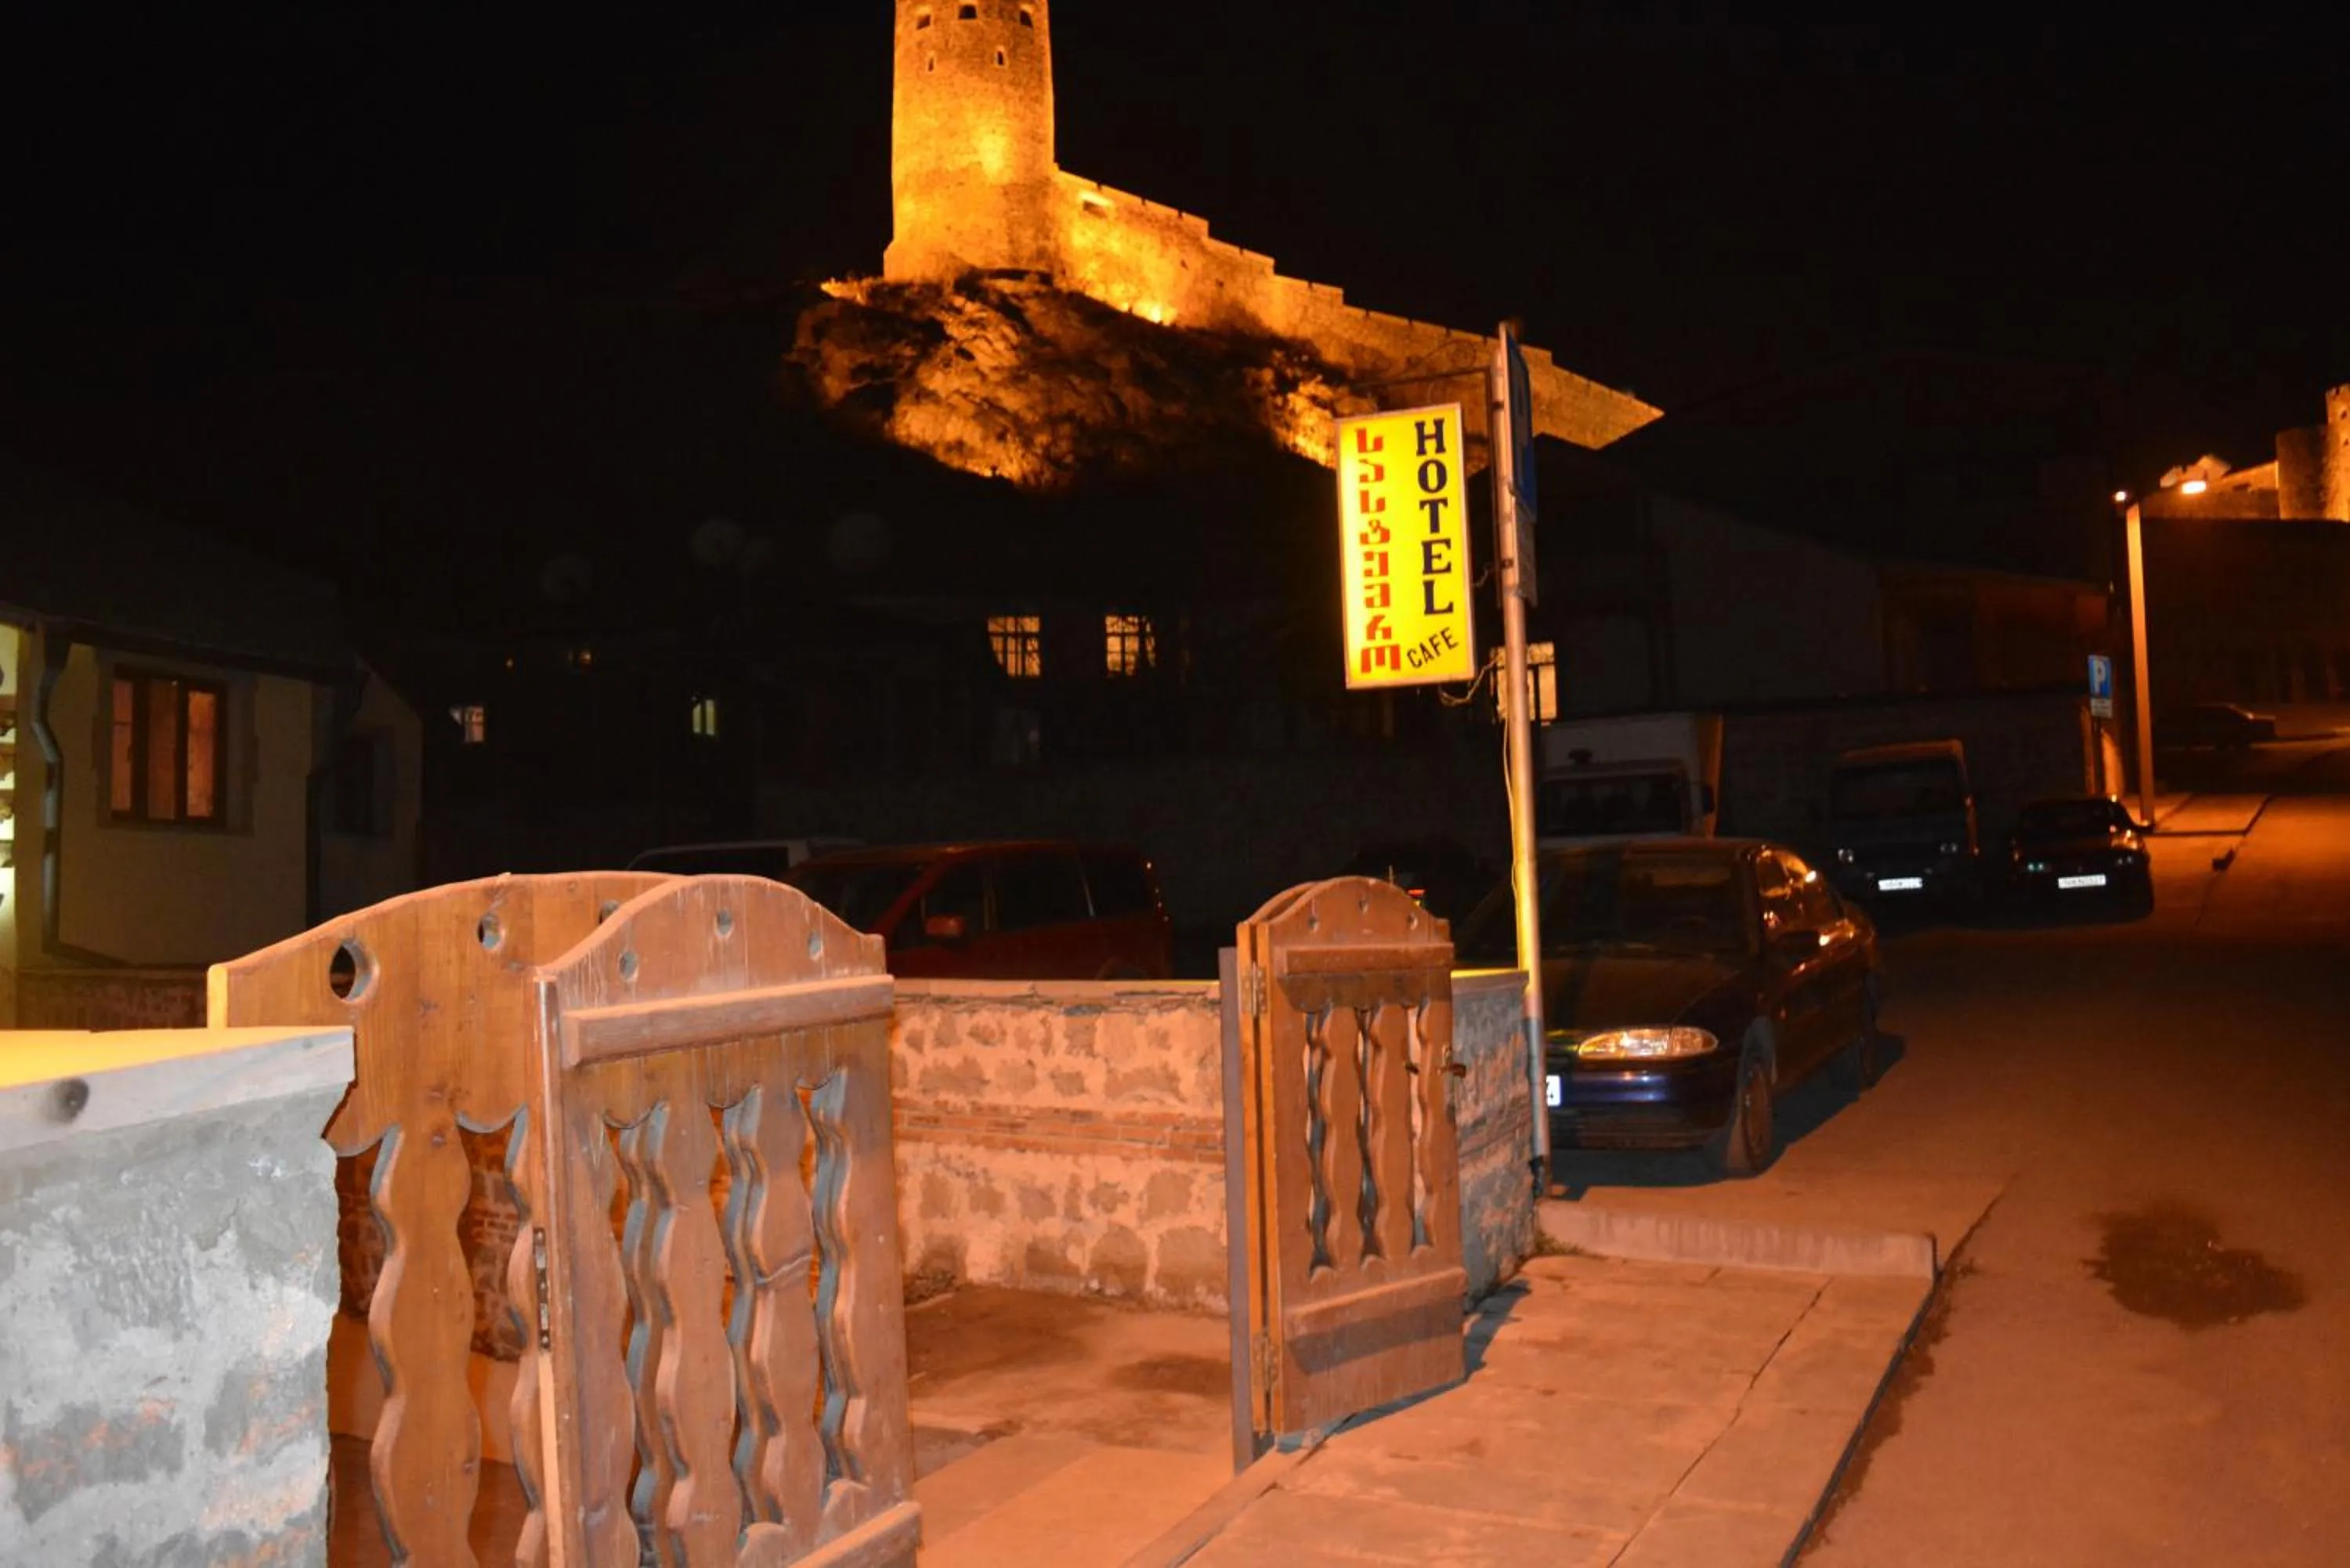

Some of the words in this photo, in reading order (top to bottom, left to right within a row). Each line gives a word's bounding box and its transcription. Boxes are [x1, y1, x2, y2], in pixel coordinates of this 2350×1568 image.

[1354, 427, 1401, 674] სასტუმრო
[1414, 417, 1455, 616] HOTEL
[1406, 627, 1459, 669] CAFE
[2092, 659, 2106, 694] P
